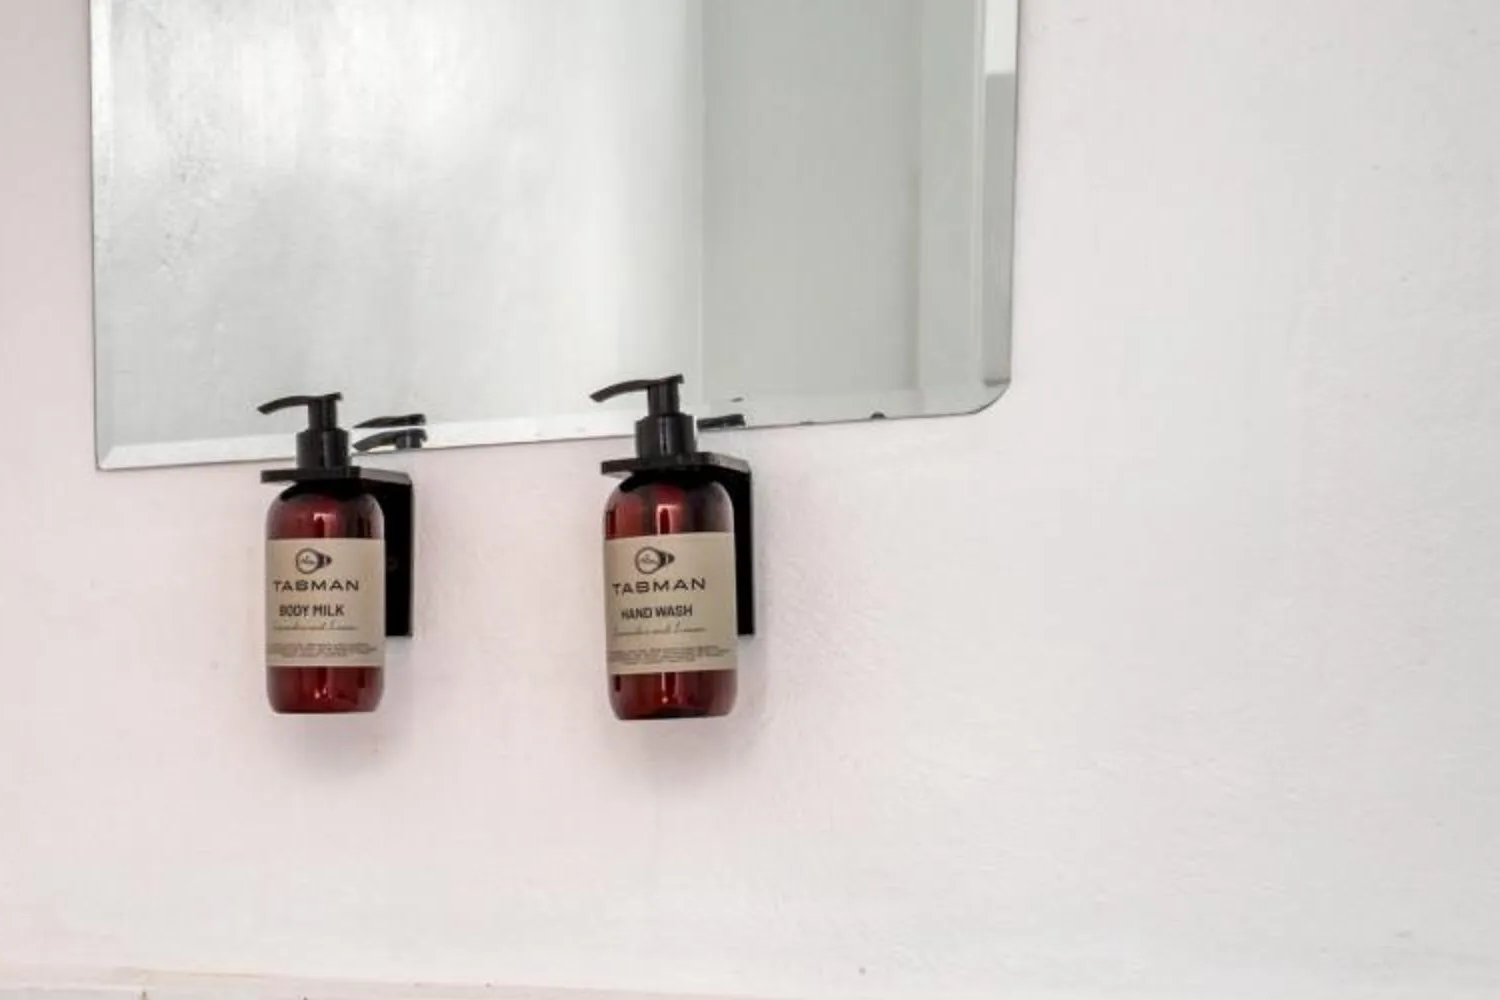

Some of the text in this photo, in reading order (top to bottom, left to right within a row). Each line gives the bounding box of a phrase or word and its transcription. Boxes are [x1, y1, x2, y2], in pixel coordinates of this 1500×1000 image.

[278, 603, 346, 617] BODY MILK
[620, 604, 694, 621] HAND WASH
